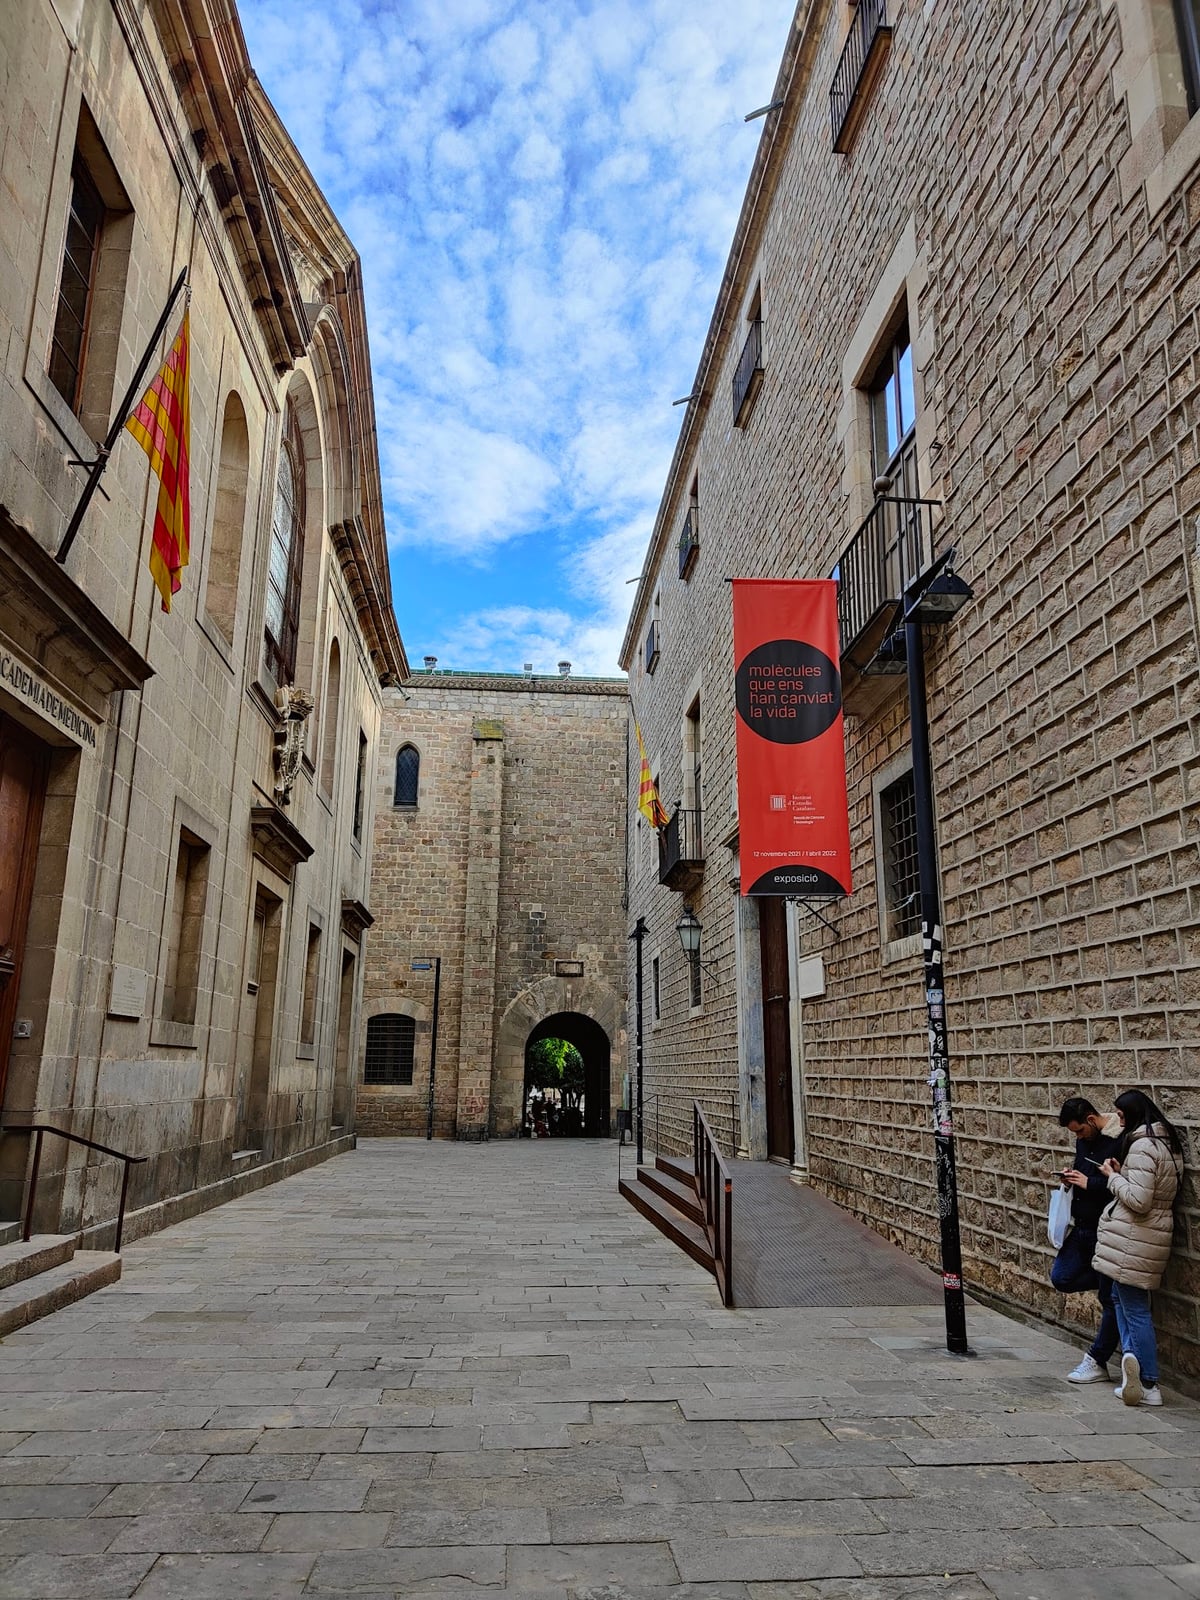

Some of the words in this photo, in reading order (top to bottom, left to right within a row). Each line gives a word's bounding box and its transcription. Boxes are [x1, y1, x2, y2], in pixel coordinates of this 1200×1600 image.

[749, 664, 822, 677] molècules
[749, 680, 775, 693] que
[778, 680, 804, 691] ens
[750, 691, 777, 705] han
[780, 691, 834, 704] canviat
[750, 705, 763, 718] la
[766, 705, 797, 718] vida
[774, 873, 819, 884] exposició
